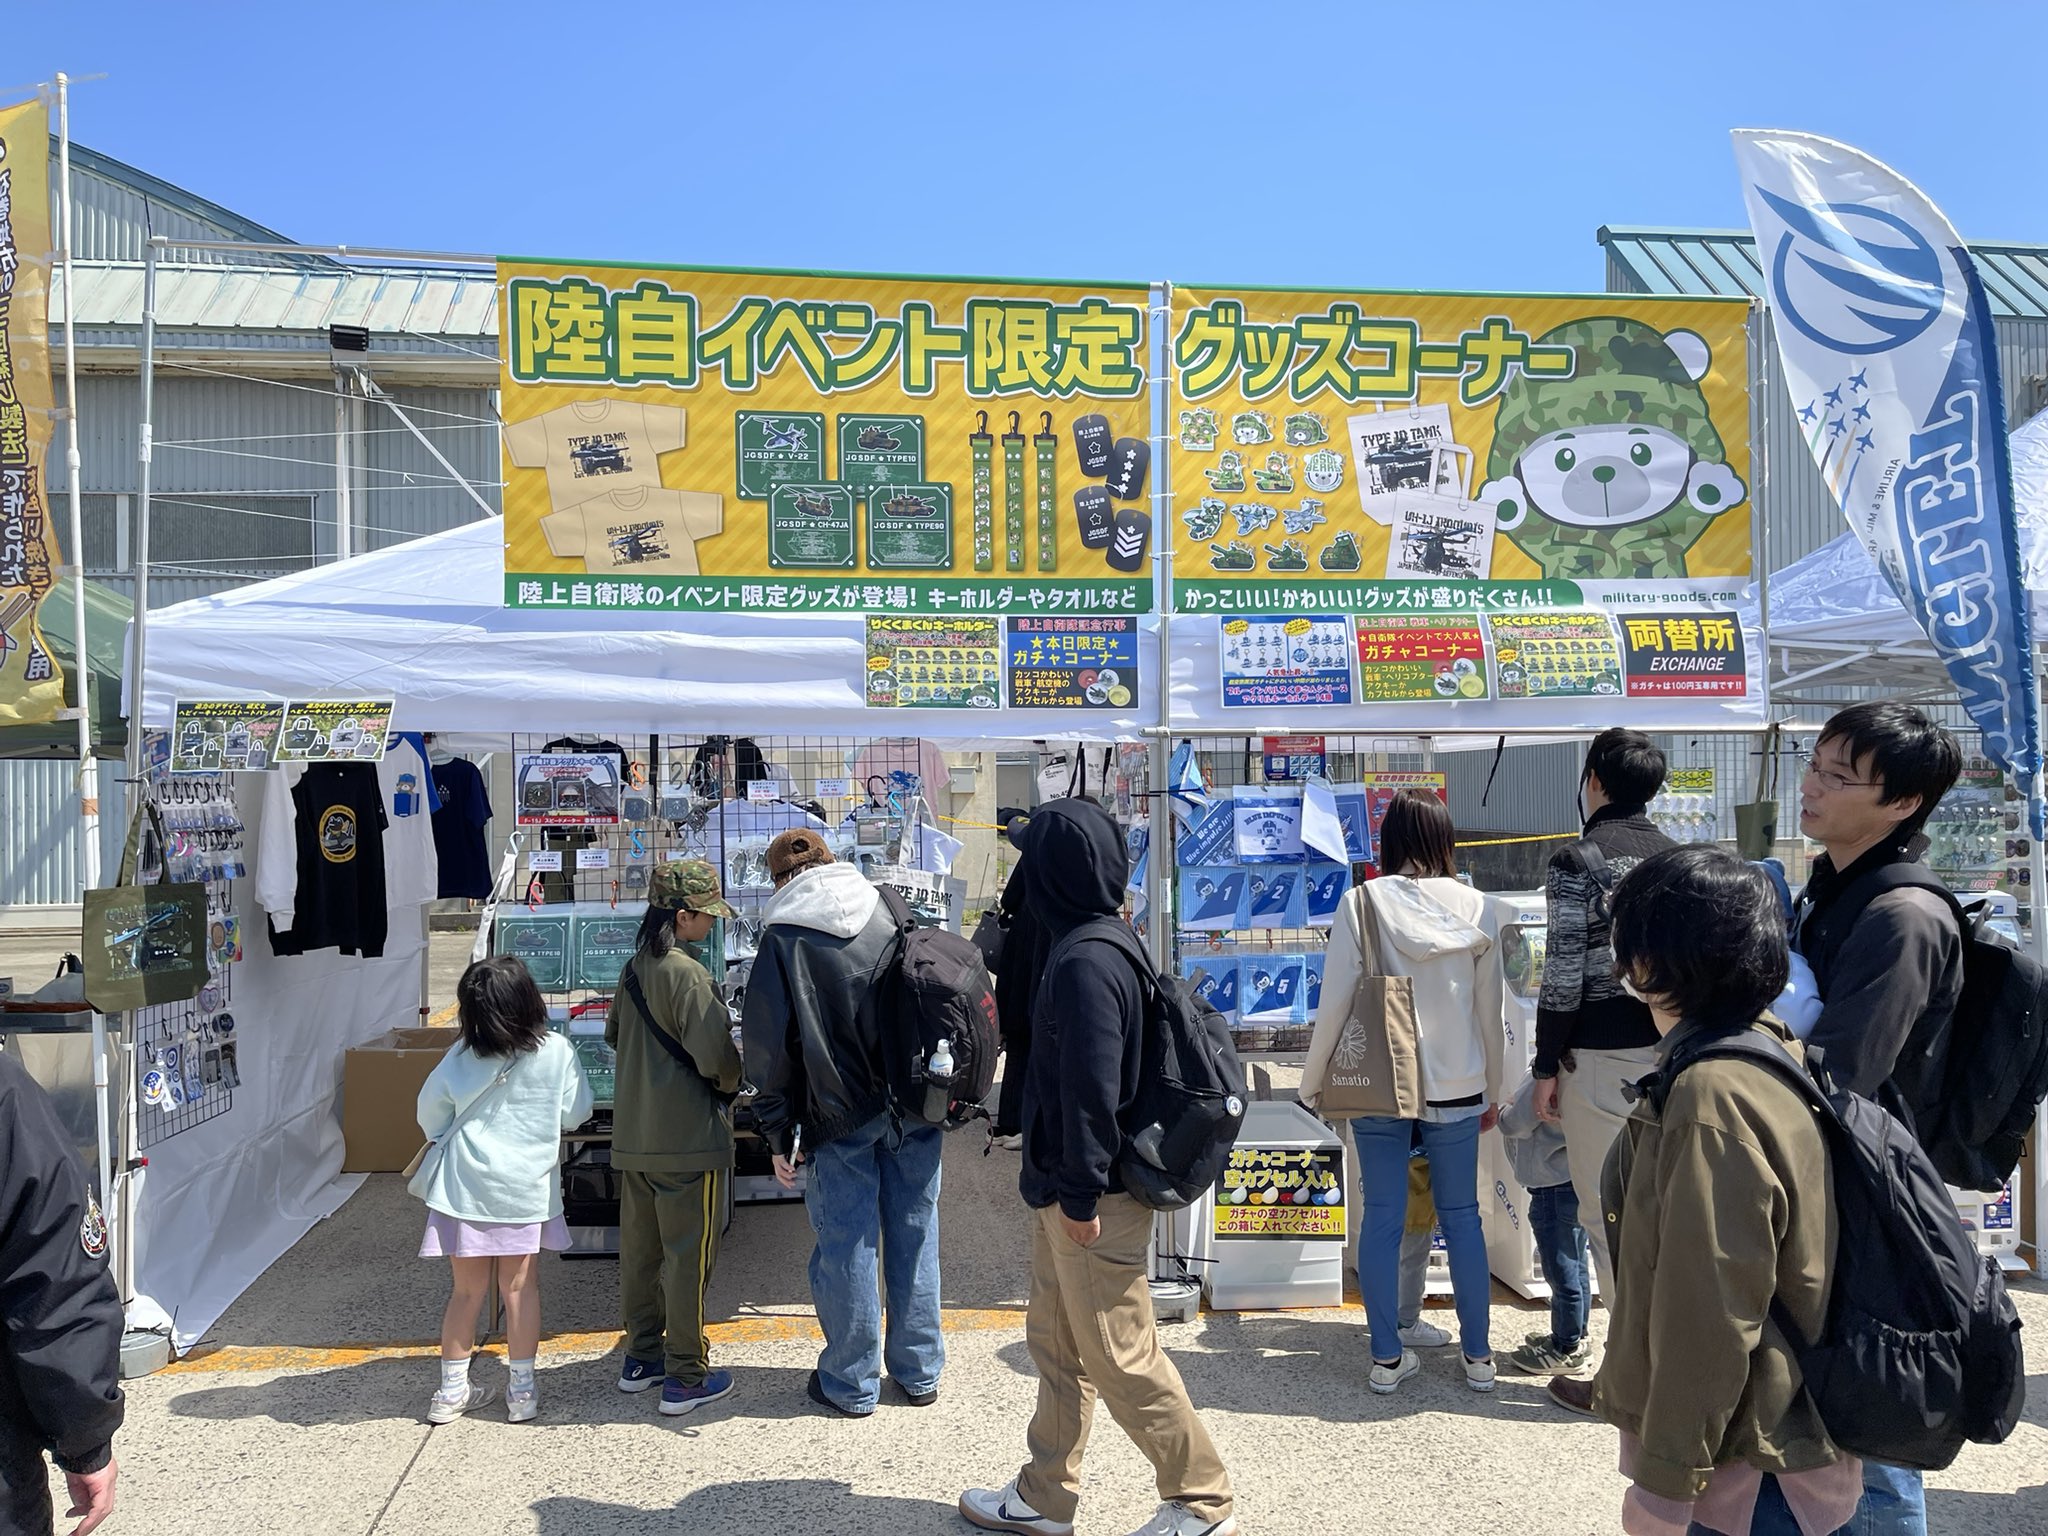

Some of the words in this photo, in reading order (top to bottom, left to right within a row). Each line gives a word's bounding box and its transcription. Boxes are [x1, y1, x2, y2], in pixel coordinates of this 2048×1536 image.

[514, 282, 1140, 392] 陸自イベント限定
[1179, 304, 1572, 402] グッズコーナー
[1361, 432, 1391, 447] TYPE
[1410, 425, 1442, 440] TANK
[745, 451, 775, 460] JGSDF
[788, 452, 809, 461] V-22
[845, 454, 876, 462] JGSDF
[886, 454, 917, 463] TYPE10
[776, 520, 807, 528] JGSDF
[817, 521, 849, 529] CH-47JA
[873, 522, 904, 530] JGSDF
[914, 523, 945, 531] TYPE90
[517, 581, 917, 608] 陸上自衛隊のイベント限定グッズが登場!
[928, 584, 1136, 610] キーホルダーやタオルなど
[1185, 586, 1554, 608] かっこいい!かわいい!グッズが盛りだくさん!!
[1602, 590, 1737, 603] military-goods.com
[1017, 618, 1127, 632] 陸上自衛隊記念行事
[1046, 635, 1106, 650] 本日限定
[1368, 631, 1472, 643] 自衛隊イベントで大人気
[1625, 618, 1736, 652] 両替所
[1013, 650, 1130, 666] ガチャコーナー
[1365, 643, 1478, 660] ガチャコーナー
[1364, 664, 1422, 673] カッコかわいい
[1650, 656, 1726, 671] EXCHANGE
[1015, 670, 1074, 678] カッコかわいい
[1014, 680, 1070, 688] 戦車・航空機の
[1366, 681, 1407, 690] アクキーが
[1015, 688, 1057, 696] アクキーが
[1367, 689, 1432, 699] カプセルから登場
[1015, 697, 1083, 706] カプセルから登場
[1262, 811, 1294, 825] IMPULSE
[1196, 827, 1209, 840] We
[1208, 816, 1220, 830] are
[1184, 848, 1201, 865] Blue
[930, 889, 954, 907] TANK
[1223, 885, 1233, 901] 1
[1271, 885, 1285, 900] 2
[1322, 884, 1335, 899] 3
[1223, 981, 1233, 998] 4
[1276, 978, 1290, 995] 5
[1331, 1073, 1370, 1087] Sanatio
[1228, 1149, 1331, 1168] ガチャコーナー
[1223, 1168, 1338, 1189] 空カプセル入れ
[1229, 1208, 1330, 1220] ガチャの空カプセルは
[1218, 1221, 1341, 1233] この箱に入れてください!!
